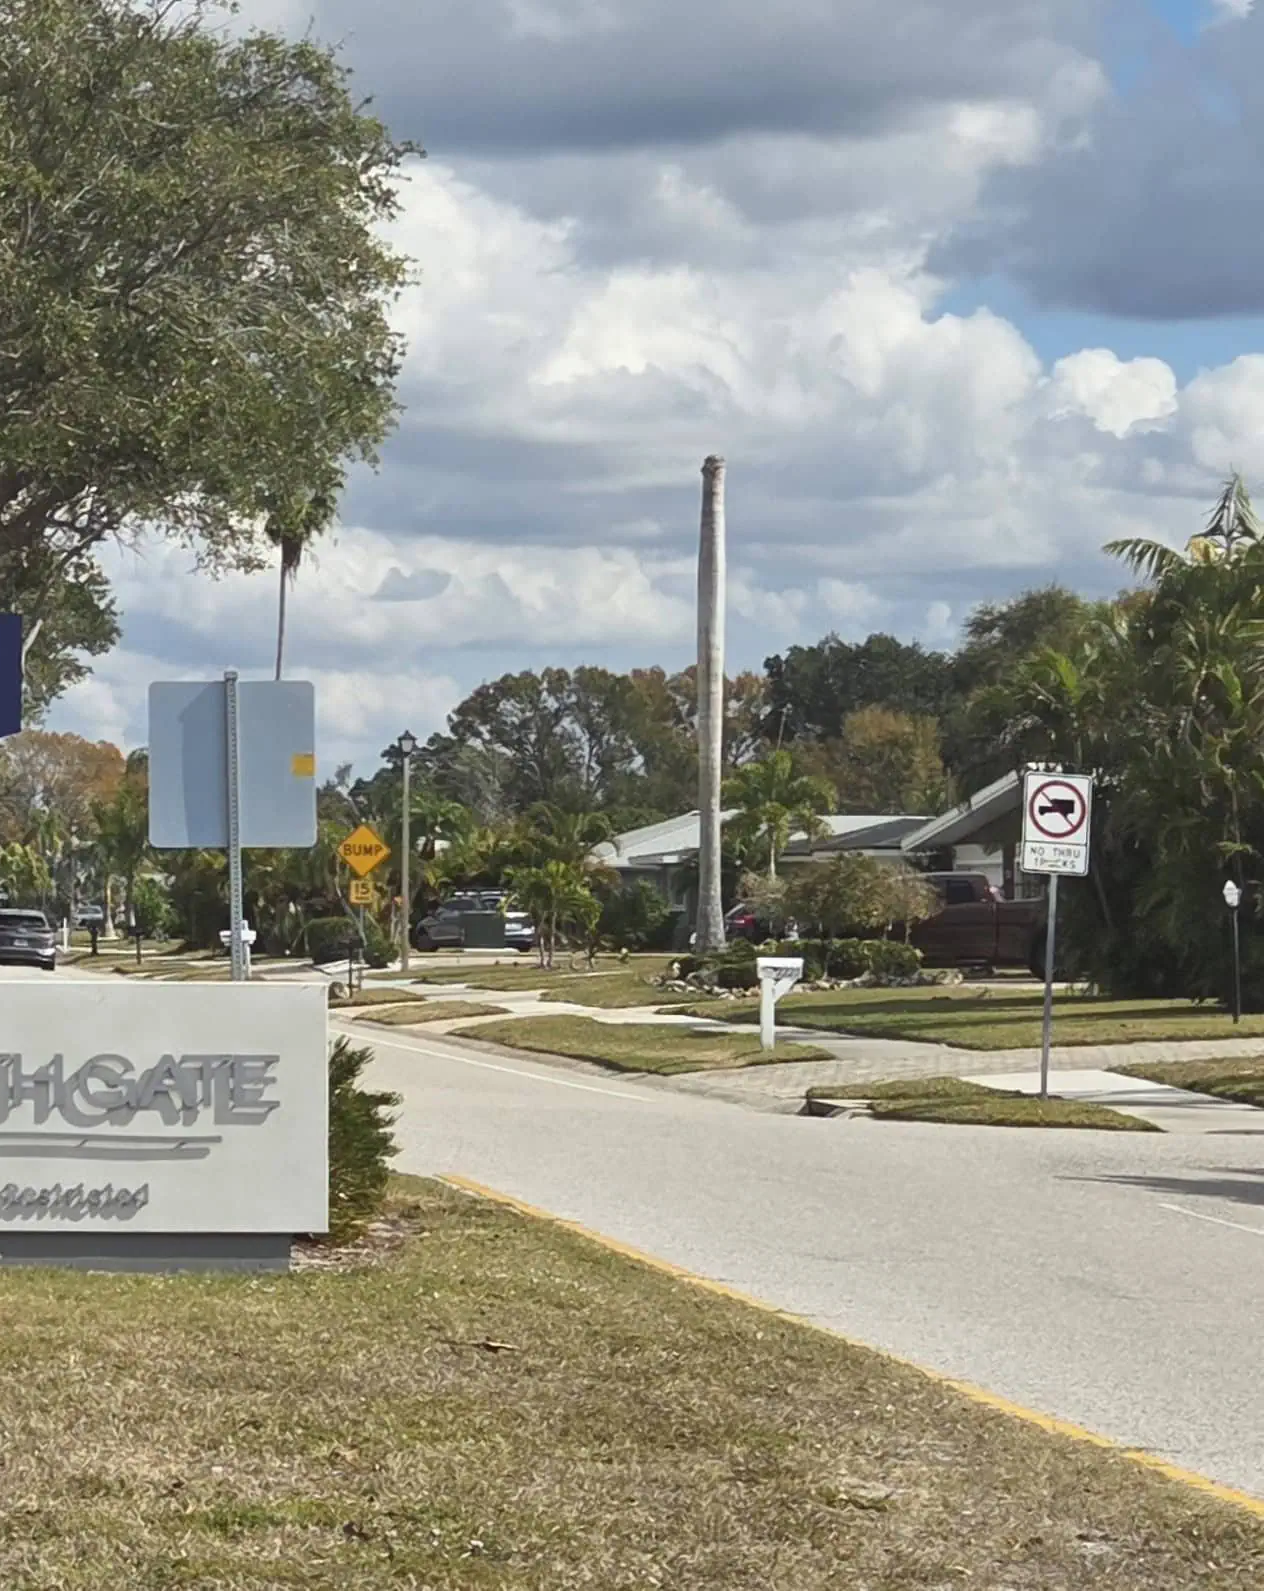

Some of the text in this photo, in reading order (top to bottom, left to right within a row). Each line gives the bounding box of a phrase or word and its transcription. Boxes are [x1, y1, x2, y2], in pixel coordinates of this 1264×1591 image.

[343, 843, 382, 856] BUMP
[1030, 846, 1081, 859] NO THRU
[355, 883, 370, 895] 15
